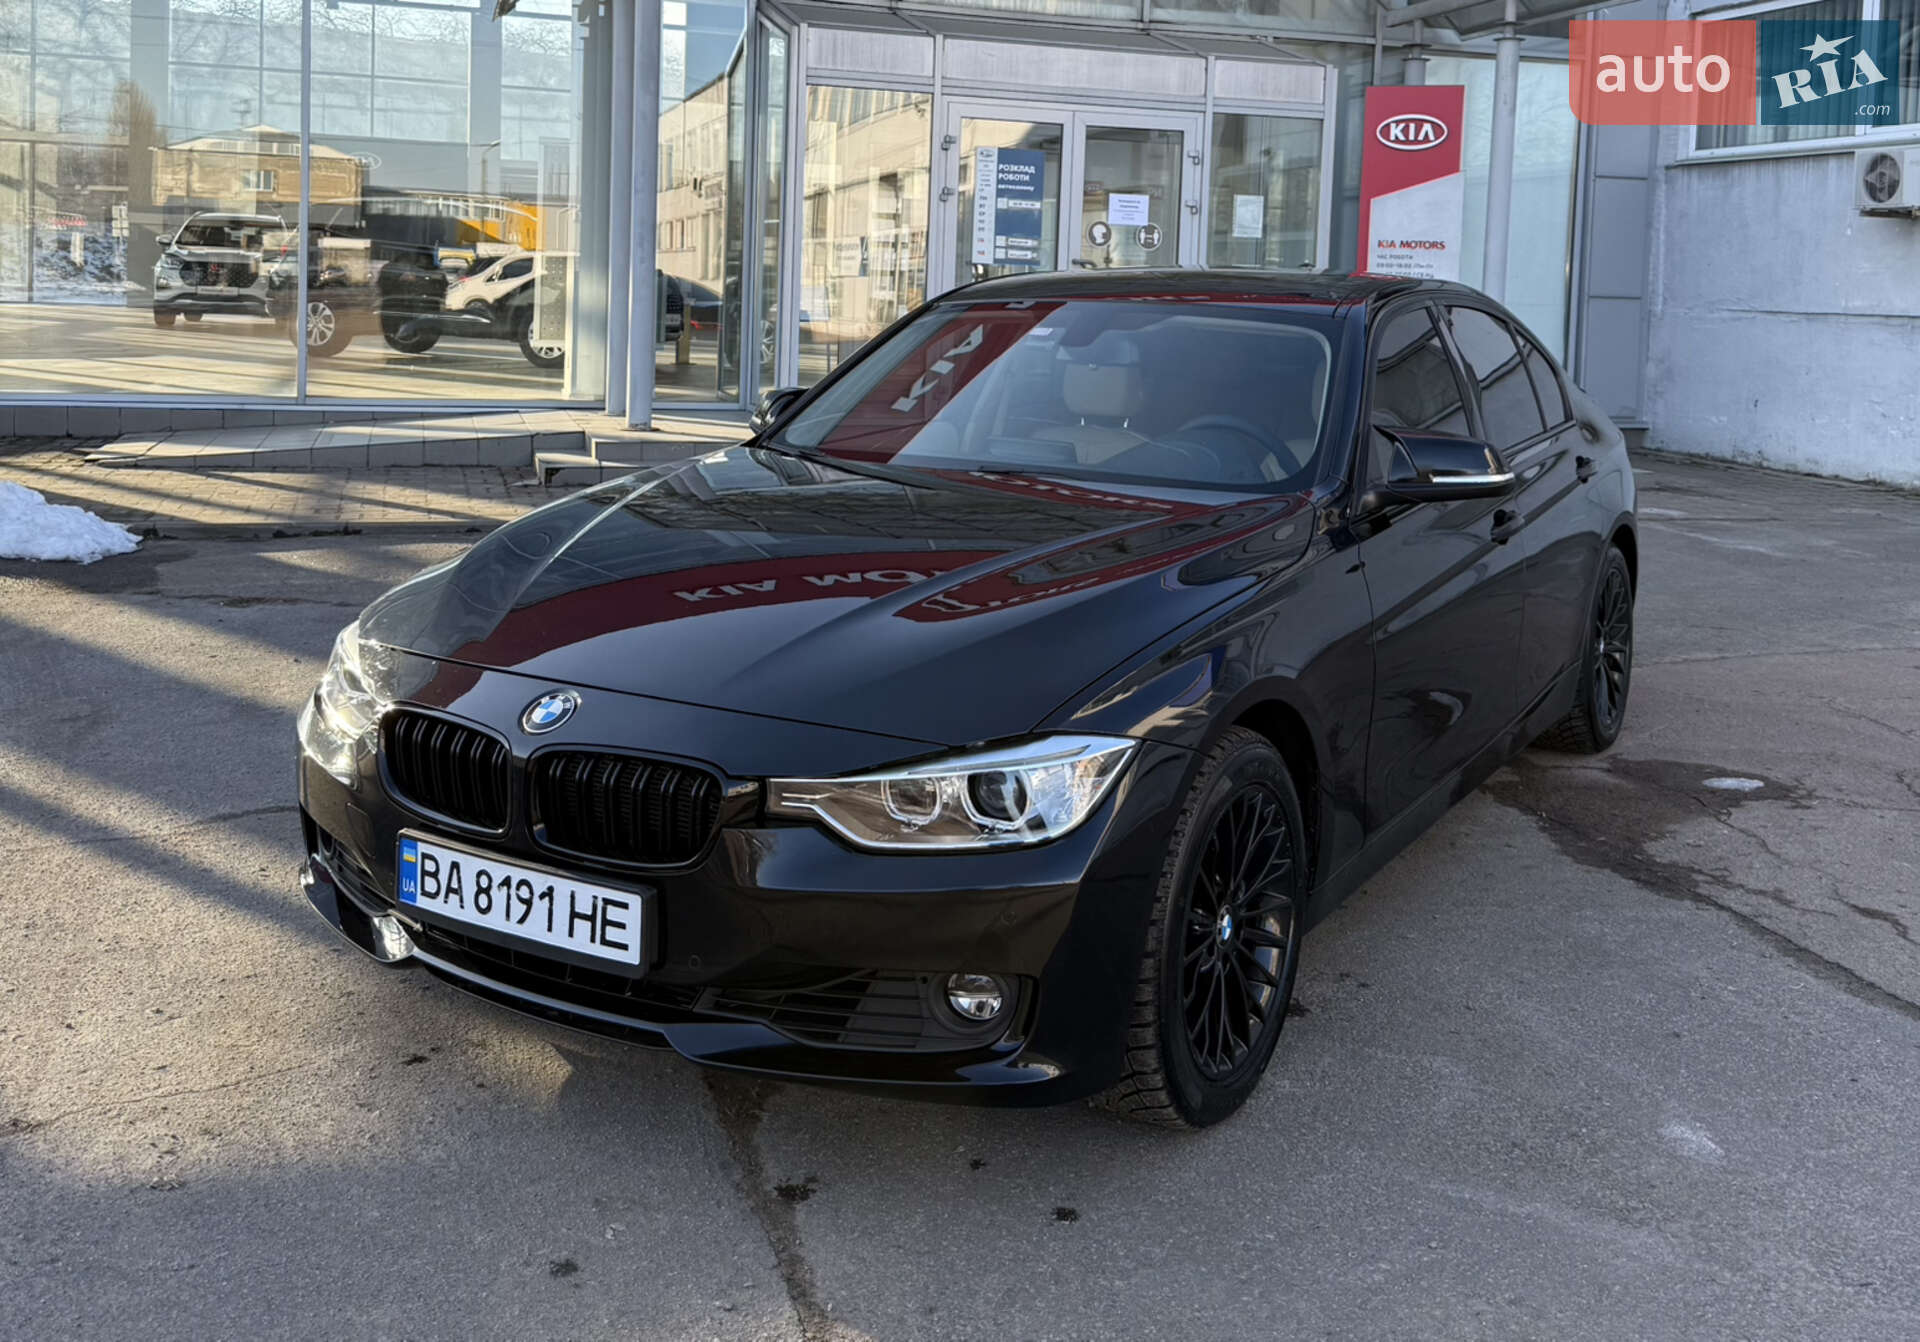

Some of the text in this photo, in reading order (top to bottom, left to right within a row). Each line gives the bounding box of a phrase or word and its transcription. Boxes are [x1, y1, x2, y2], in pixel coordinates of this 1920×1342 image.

[1389, 122, 1436, 142] KIA
[998, 163, 1036, 174] РОЗКЛАД
[998, 172, 1030, 182] РОБОТИ
[1377, 239, 1446, 250] KIA MOTORS
[402, 877, 416, 893] UA
[419, 851, 630, 952] BA 8191 HE
